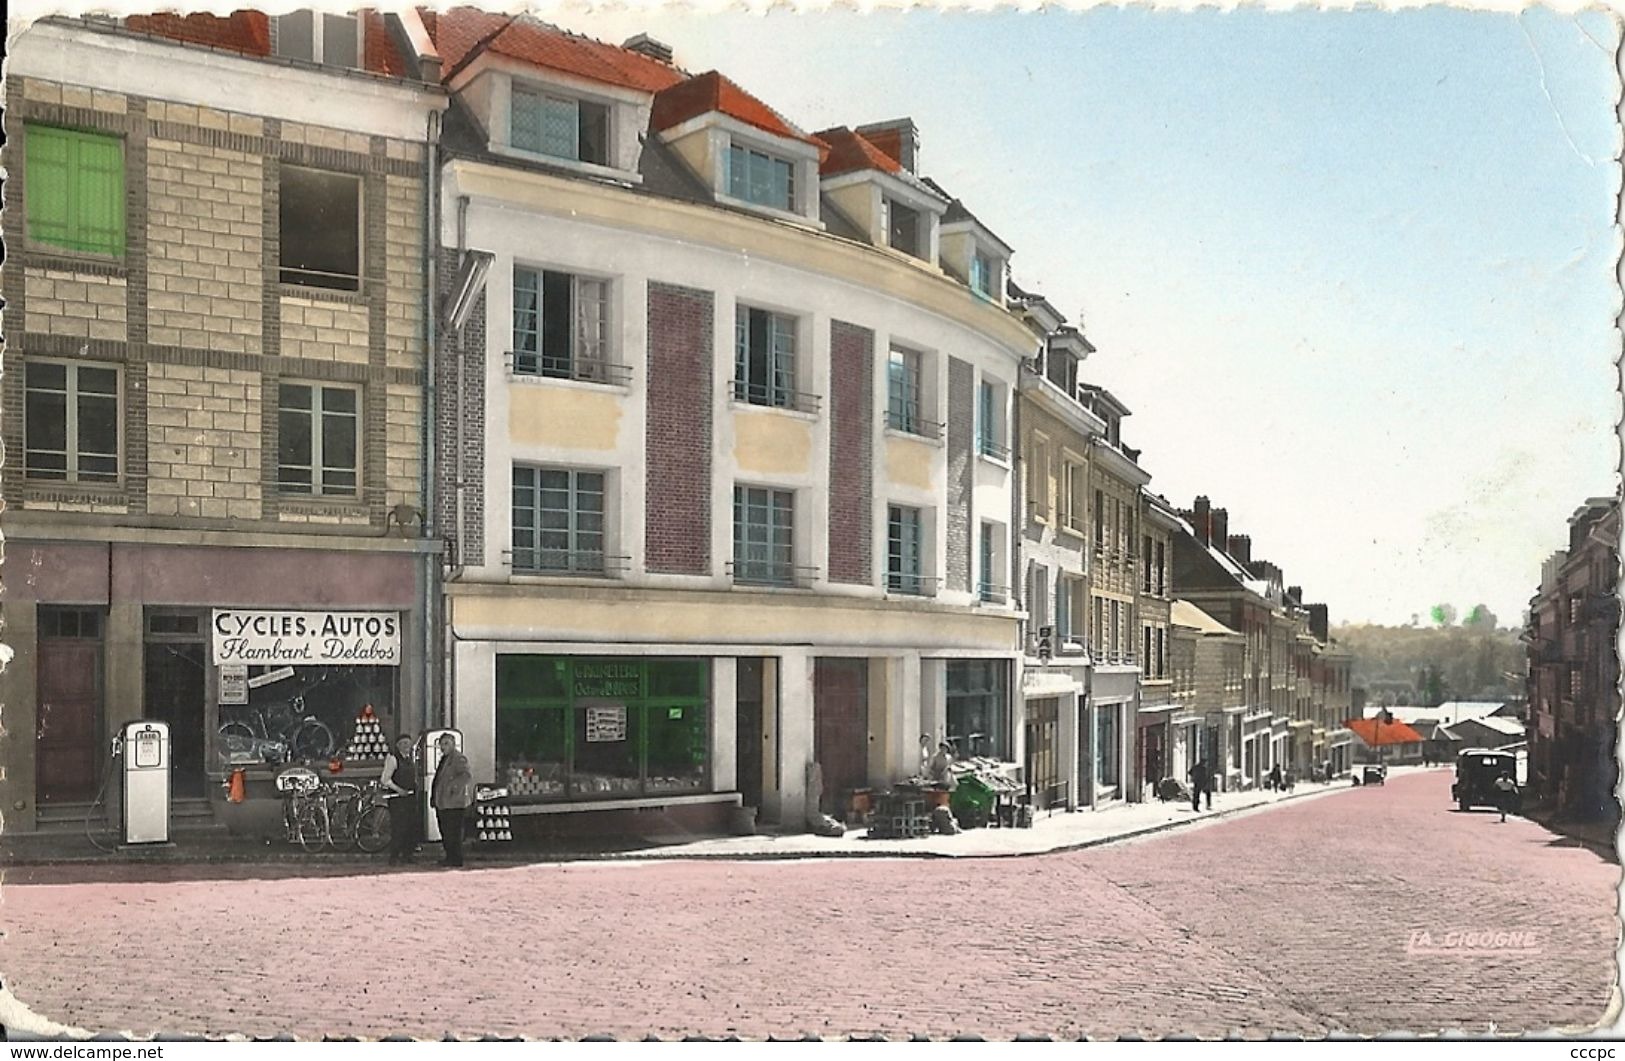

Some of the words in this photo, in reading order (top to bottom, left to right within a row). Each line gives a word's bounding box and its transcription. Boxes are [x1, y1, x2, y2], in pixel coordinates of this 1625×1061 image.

[321, 614, 396, 638] AUTOS
[320, 638, 395, 660] Delabos
[1039, 627, 1052, 660] BAR
